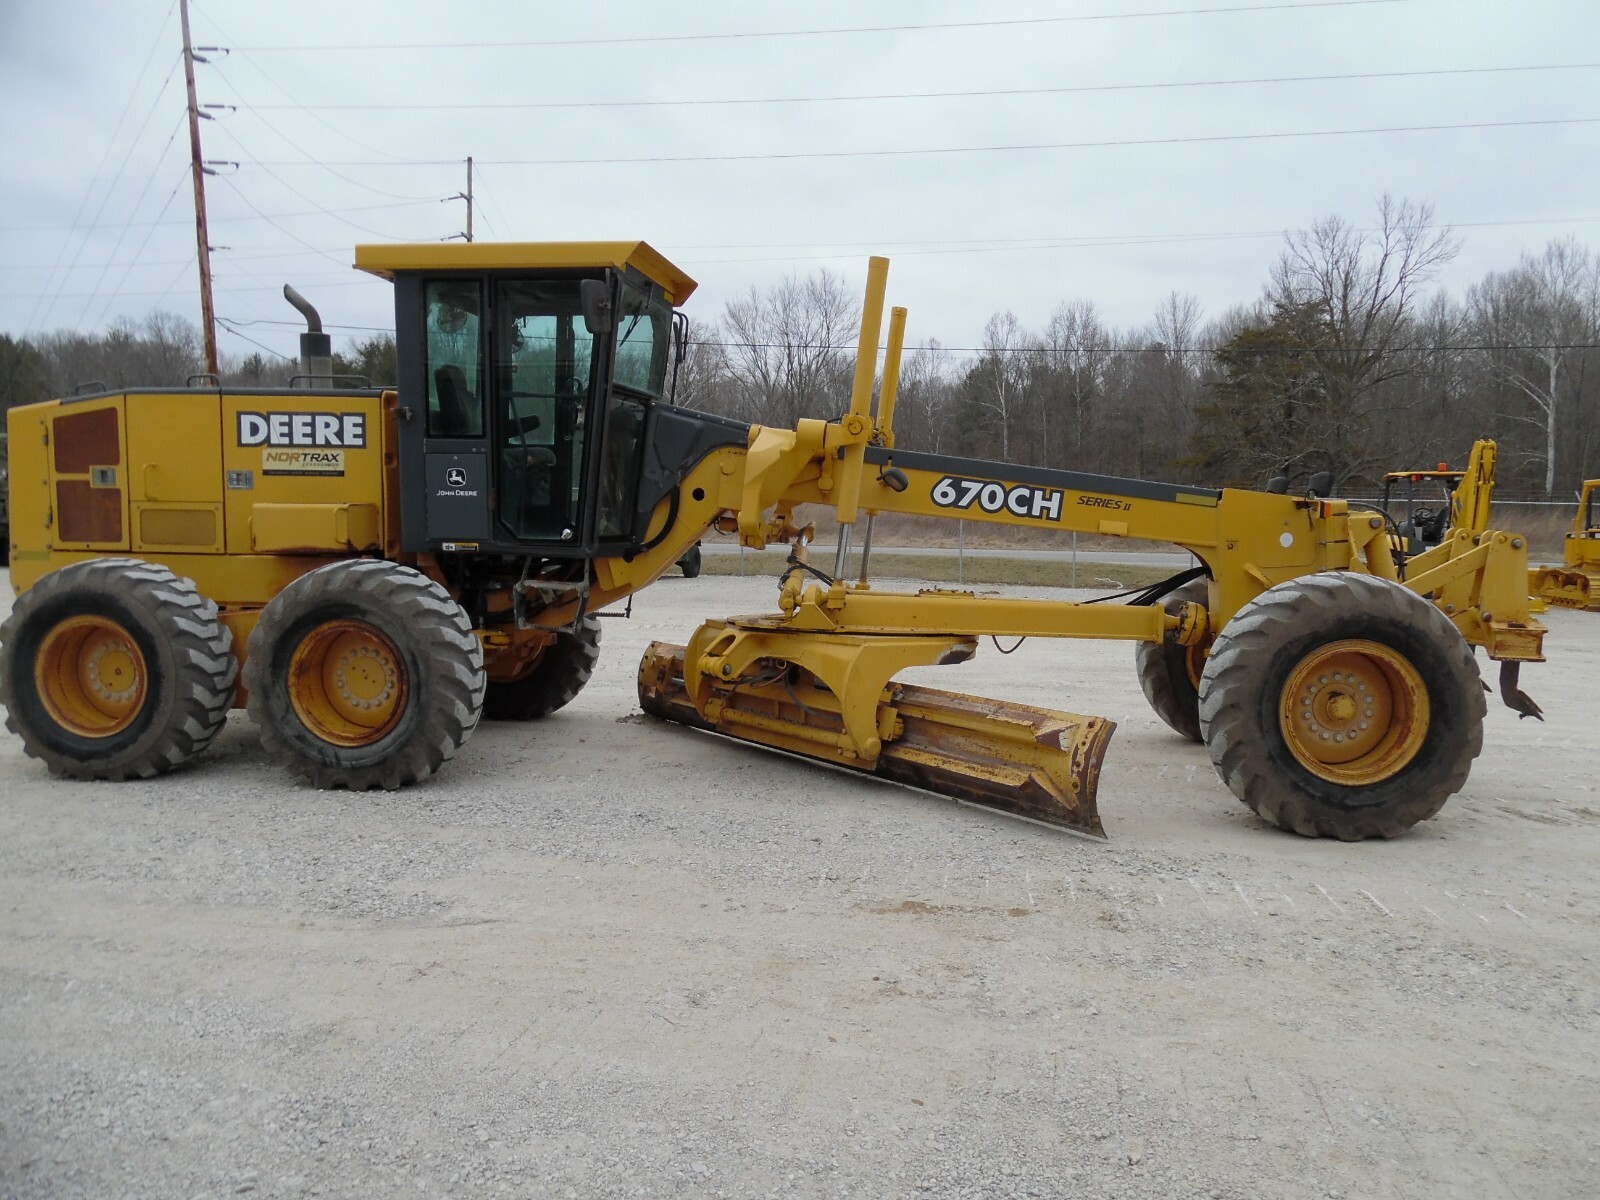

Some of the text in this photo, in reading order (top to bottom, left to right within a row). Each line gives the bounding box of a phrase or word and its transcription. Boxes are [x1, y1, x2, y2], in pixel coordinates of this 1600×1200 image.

[240, 414, 363, 446] DEERE
[266, 452, 340, 464] NORTRAX
[455, 489, 478, 497] DEERE
[933, 478, 1061, 519] 670CH
[1076, 495, 1132, 511] SERIES II
